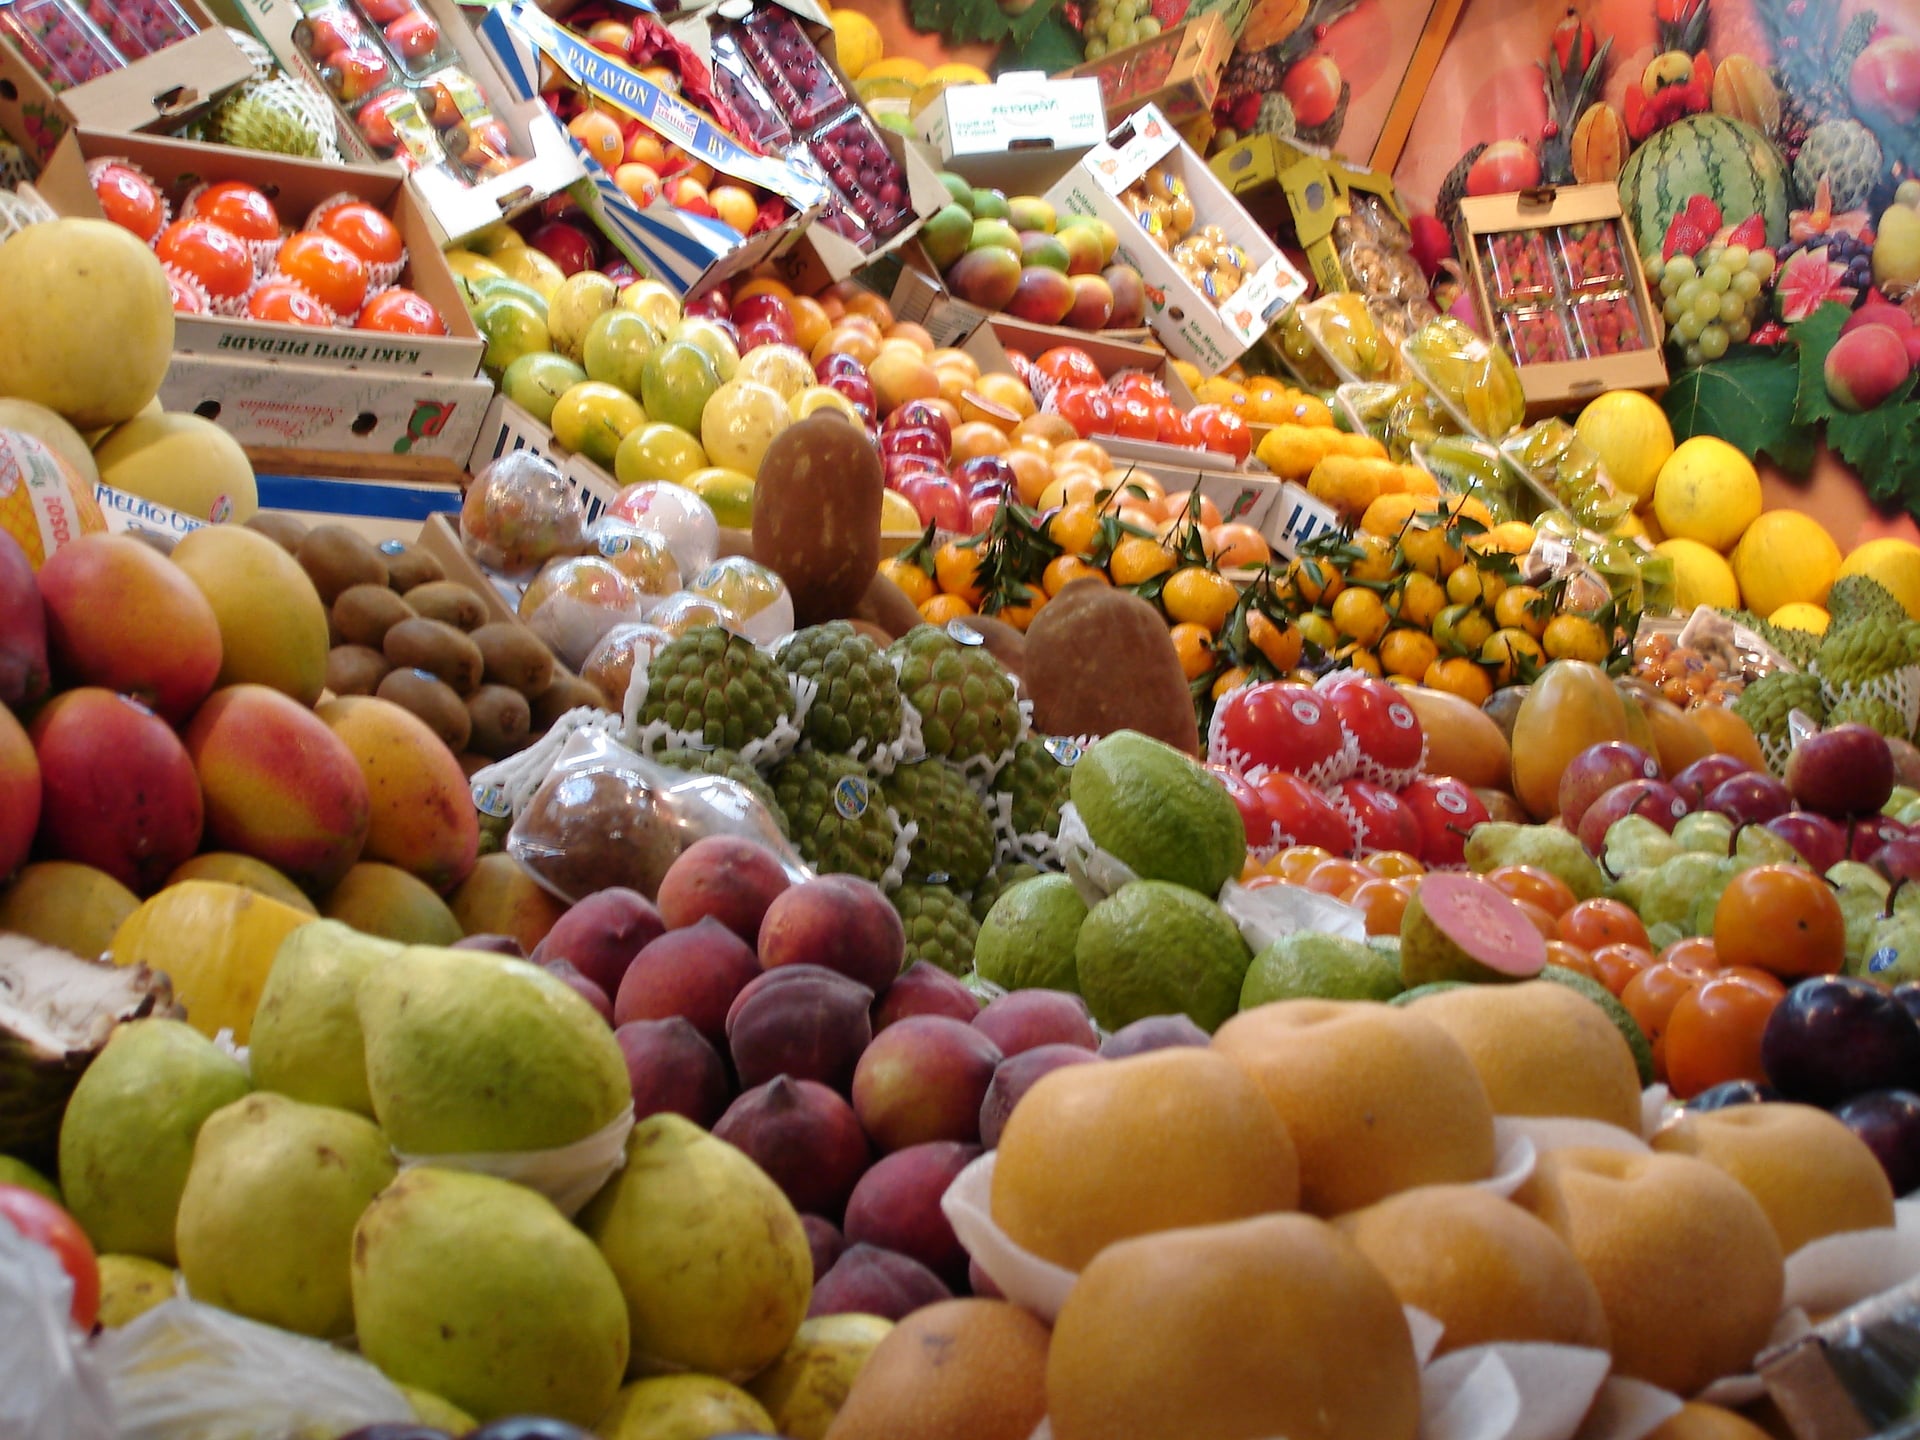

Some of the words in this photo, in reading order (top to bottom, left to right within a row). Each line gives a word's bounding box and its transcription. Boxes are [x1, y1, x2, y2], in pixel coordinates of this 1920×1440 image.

[567, 47, 598, 79] PAR
[599, 66, 649, 108] AVION
[707, 135, 728, 161] BY
[217, 332, 309, 357] PIEDADE
[312, 342, 368, 361] FUYU
[372, 350, 420, 365] KAKI
[96, 483, 166, 524] MELÃO
[43, 496, 70, 549] OSO!
